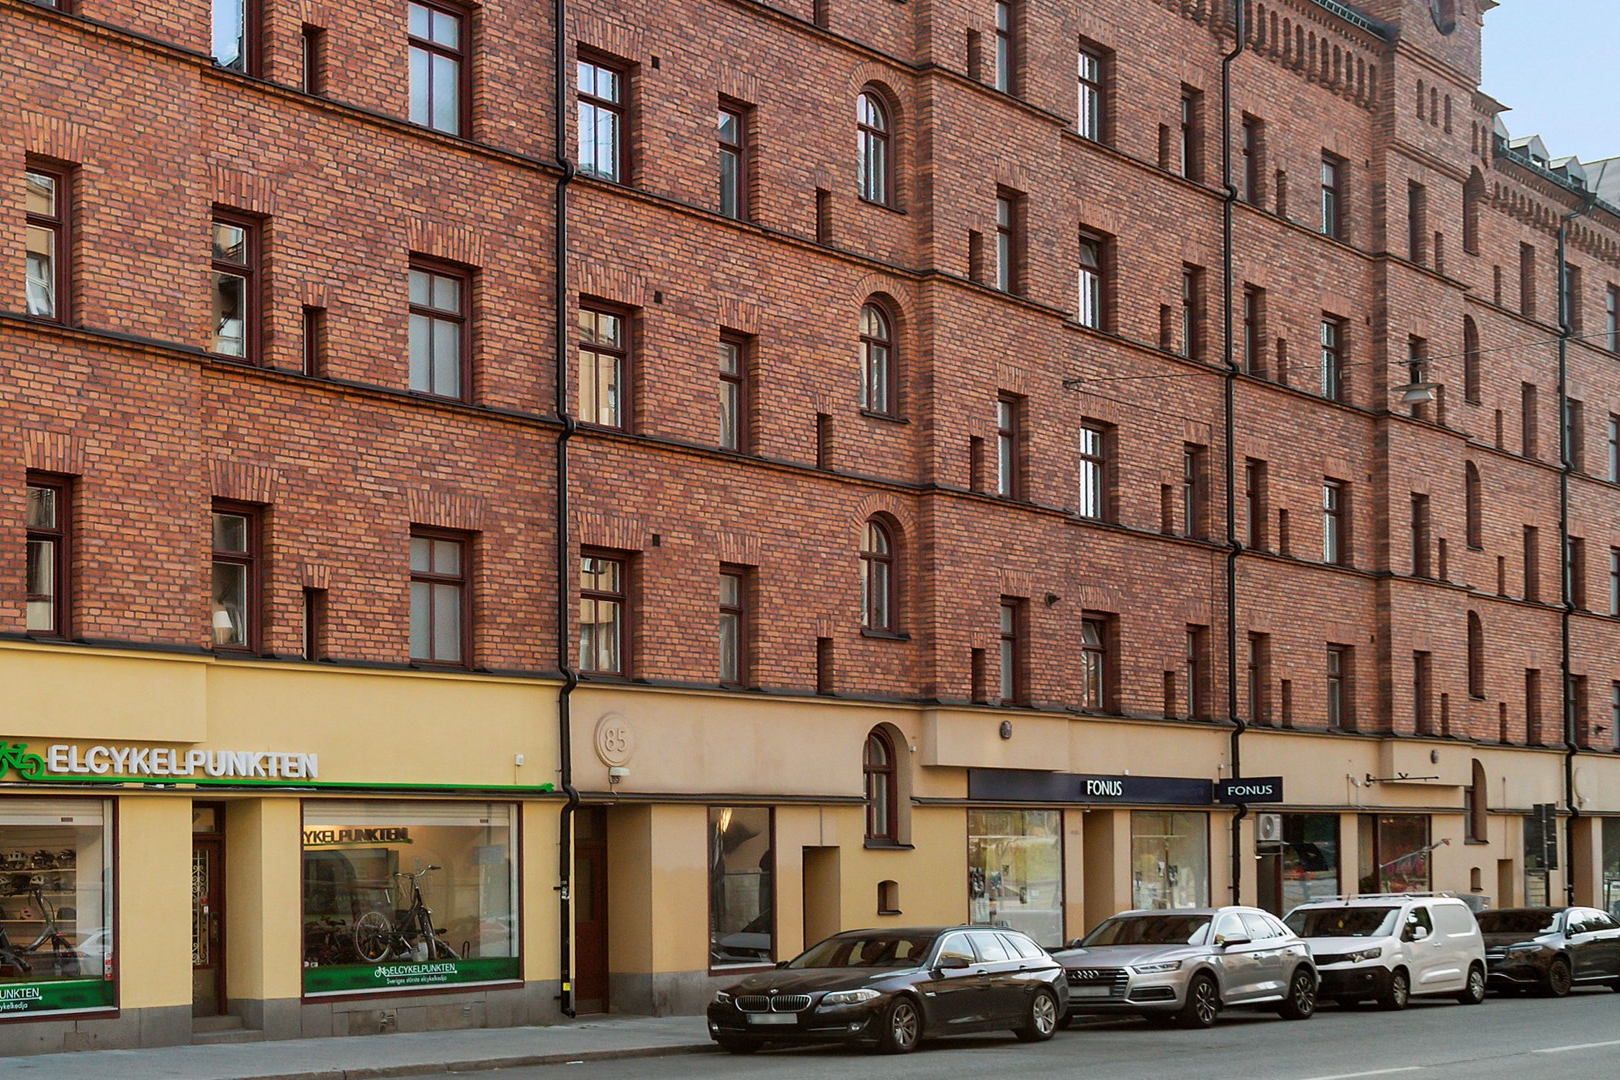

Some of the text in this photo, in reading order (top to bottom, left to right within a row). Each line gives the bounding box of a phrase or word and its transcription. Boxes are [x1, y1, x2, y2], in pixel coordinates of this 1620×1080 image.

[605, 727, 627, 752] 85
[47, 744, 318, 778] ELCYKELPUNKTEN
[1086, 779, 1123, 796] FONUS
[1227, 784, 1273, 796] FONUS
[389, 963, 455, 975] ELCYKELPUNKTEN
